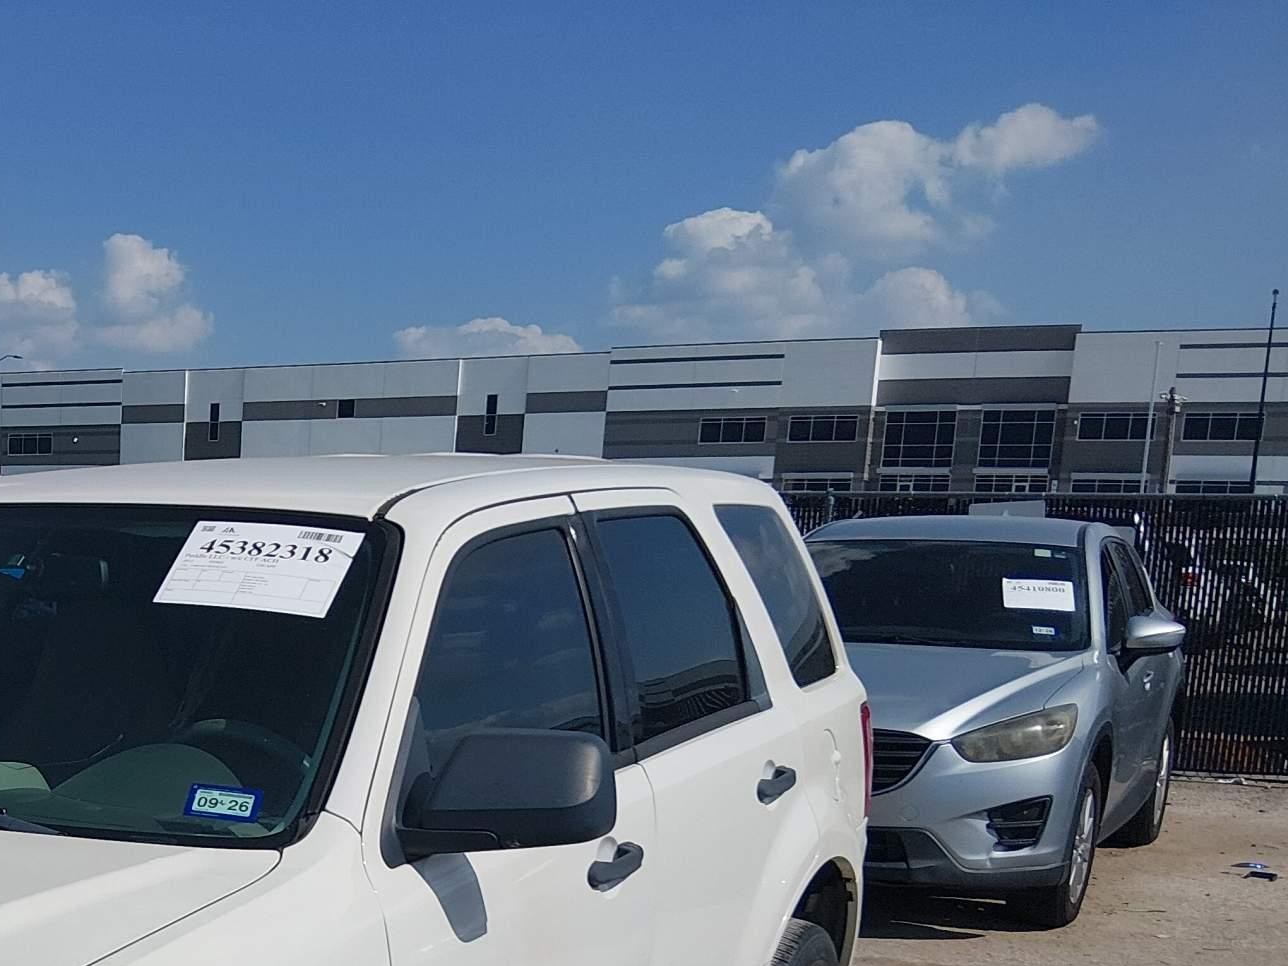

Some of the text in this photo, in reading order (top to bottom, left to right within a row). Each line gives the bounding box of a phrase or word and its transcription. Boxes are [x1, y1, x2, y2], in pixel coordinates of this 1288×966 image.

[200, 538, 333, 563] 45382318
[197, 796, 250, 812] 09 26
